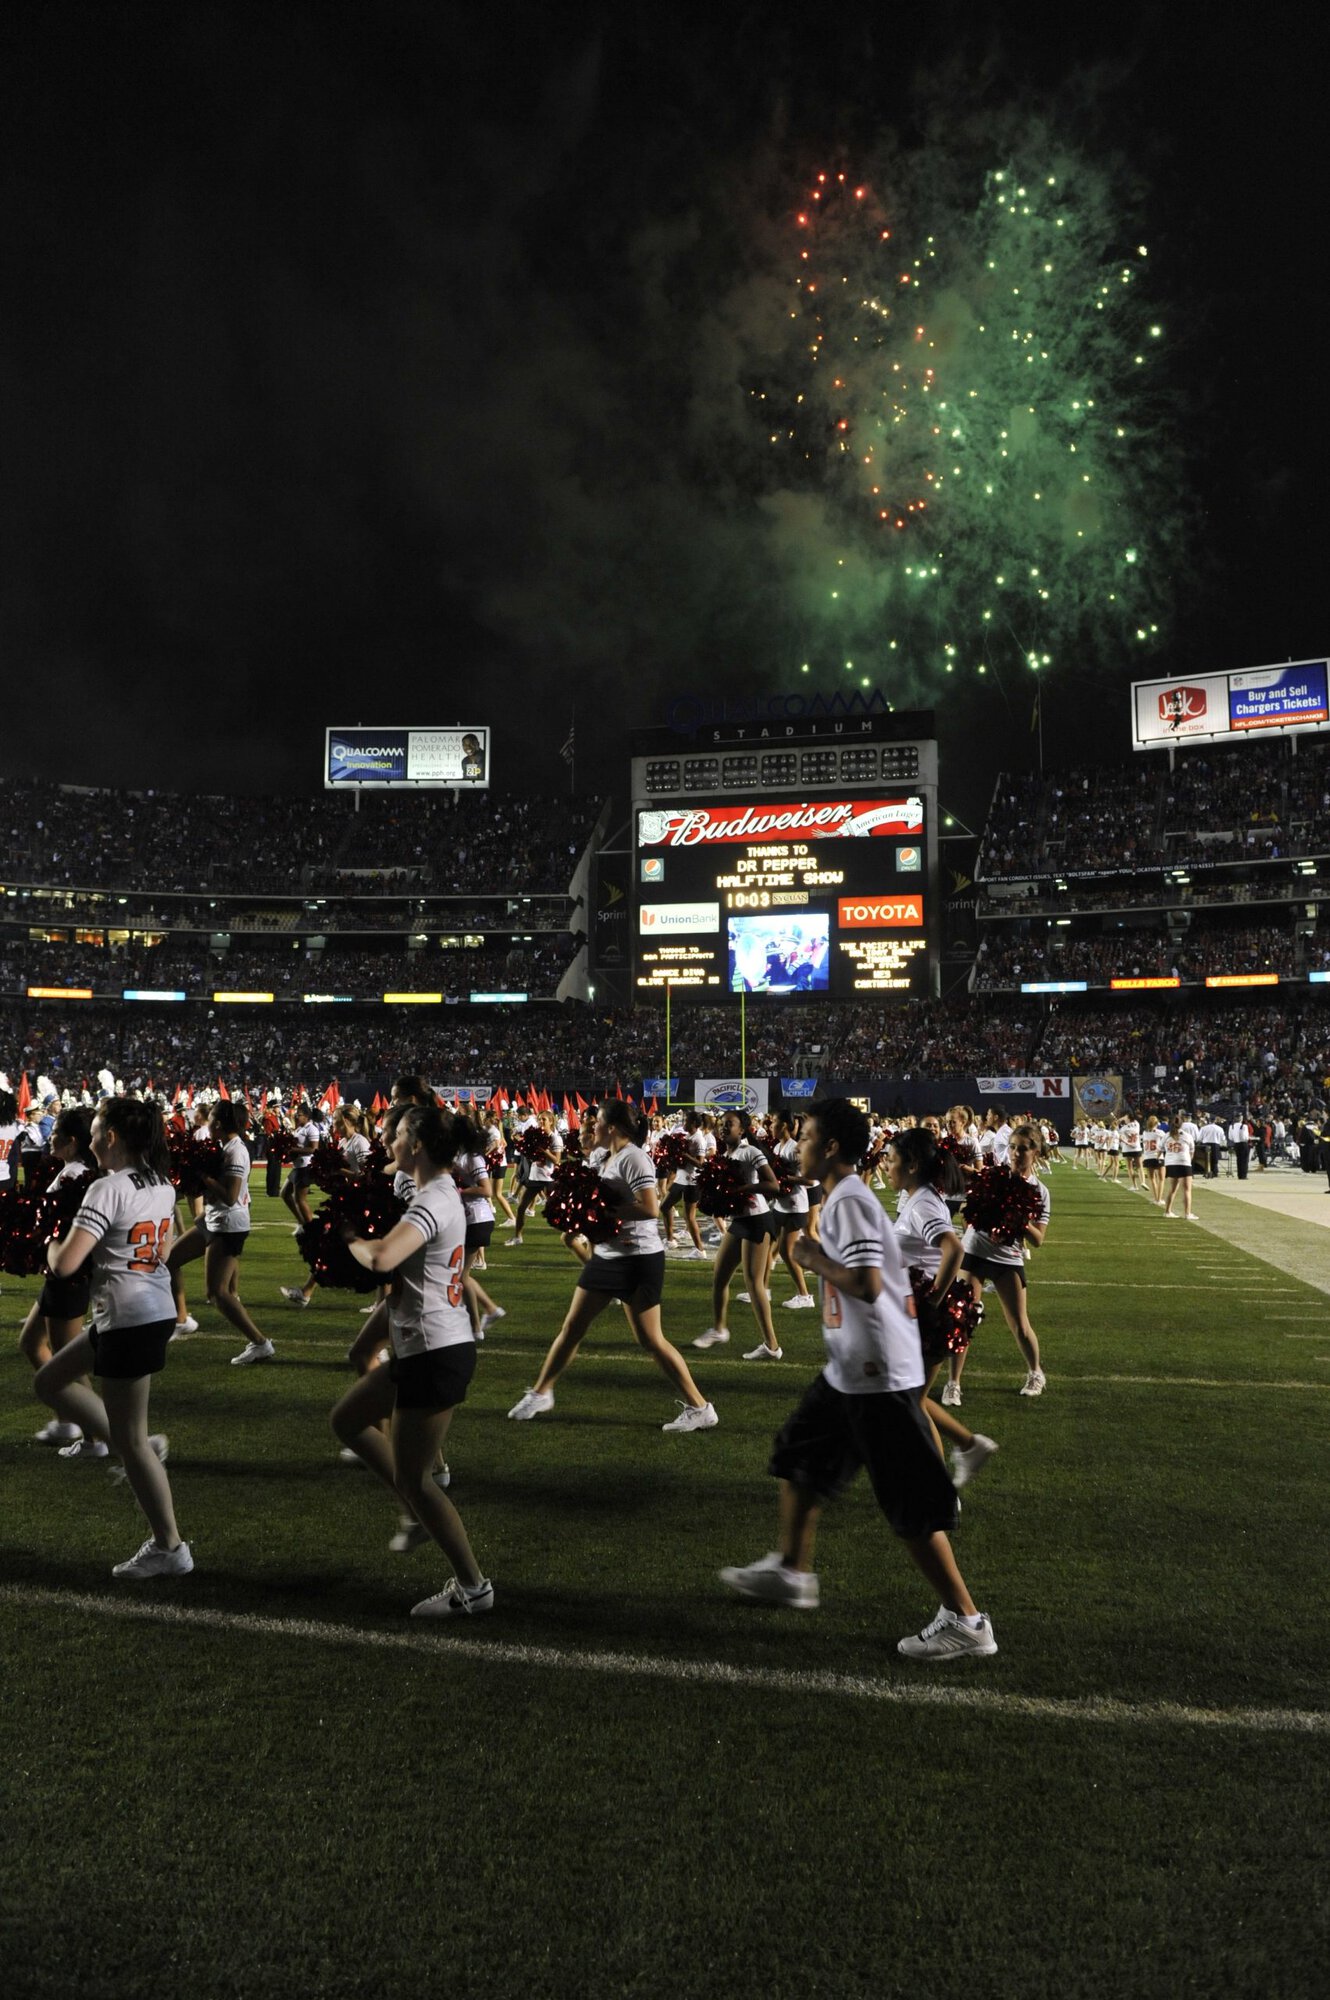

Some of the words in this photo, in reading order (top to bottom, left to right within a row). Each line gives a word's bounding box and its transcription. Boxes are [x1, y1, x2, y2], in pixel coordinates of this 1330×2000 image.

[1248, 691, 1266, 702] Buy
[1268, 687, 1287, 699] and
[1288, 684, 1308, 697] Sell
[667, 689, 889, 735] QUALCOMM
[1236, 702, 1281, 715] Chargers
[1283, 695, 1321, 710] Tickets!
[713, 720, 873, 739] STADIUM
[411, 735, 461, 744] PALOMAR
[333, 745, 404, 761] QUALCOMM
[411, 744, 461, 752] POMERADO
[661, 803, 853, 846] Budweiser
[855, 811, 894, 831] American
[895, 809, 921, 819] Lager
[746, 846, 789, 857] THANKS
[792, 845, 809, 856] TO
[736, 860, 758, 872] DR
[762, 857, 818, 872] PEPPER
[716, 873, 795, 888] HALFTIME
[803, 870, 844, 885] SHOW
[727, 892, 770, 908] 10:03
[597, 910, 627, 922] Sprint
[660, 914, 717, 924] UnionBank
[842, 904, 919, 921] TOYOTA
[1112, 980, 1146, 989] WELLS
[1147, 978, 1179, 987] FARGO
[712, 1085, 736, 1096] PACIFIC
[1042, 1078, 1062, 1096] N
